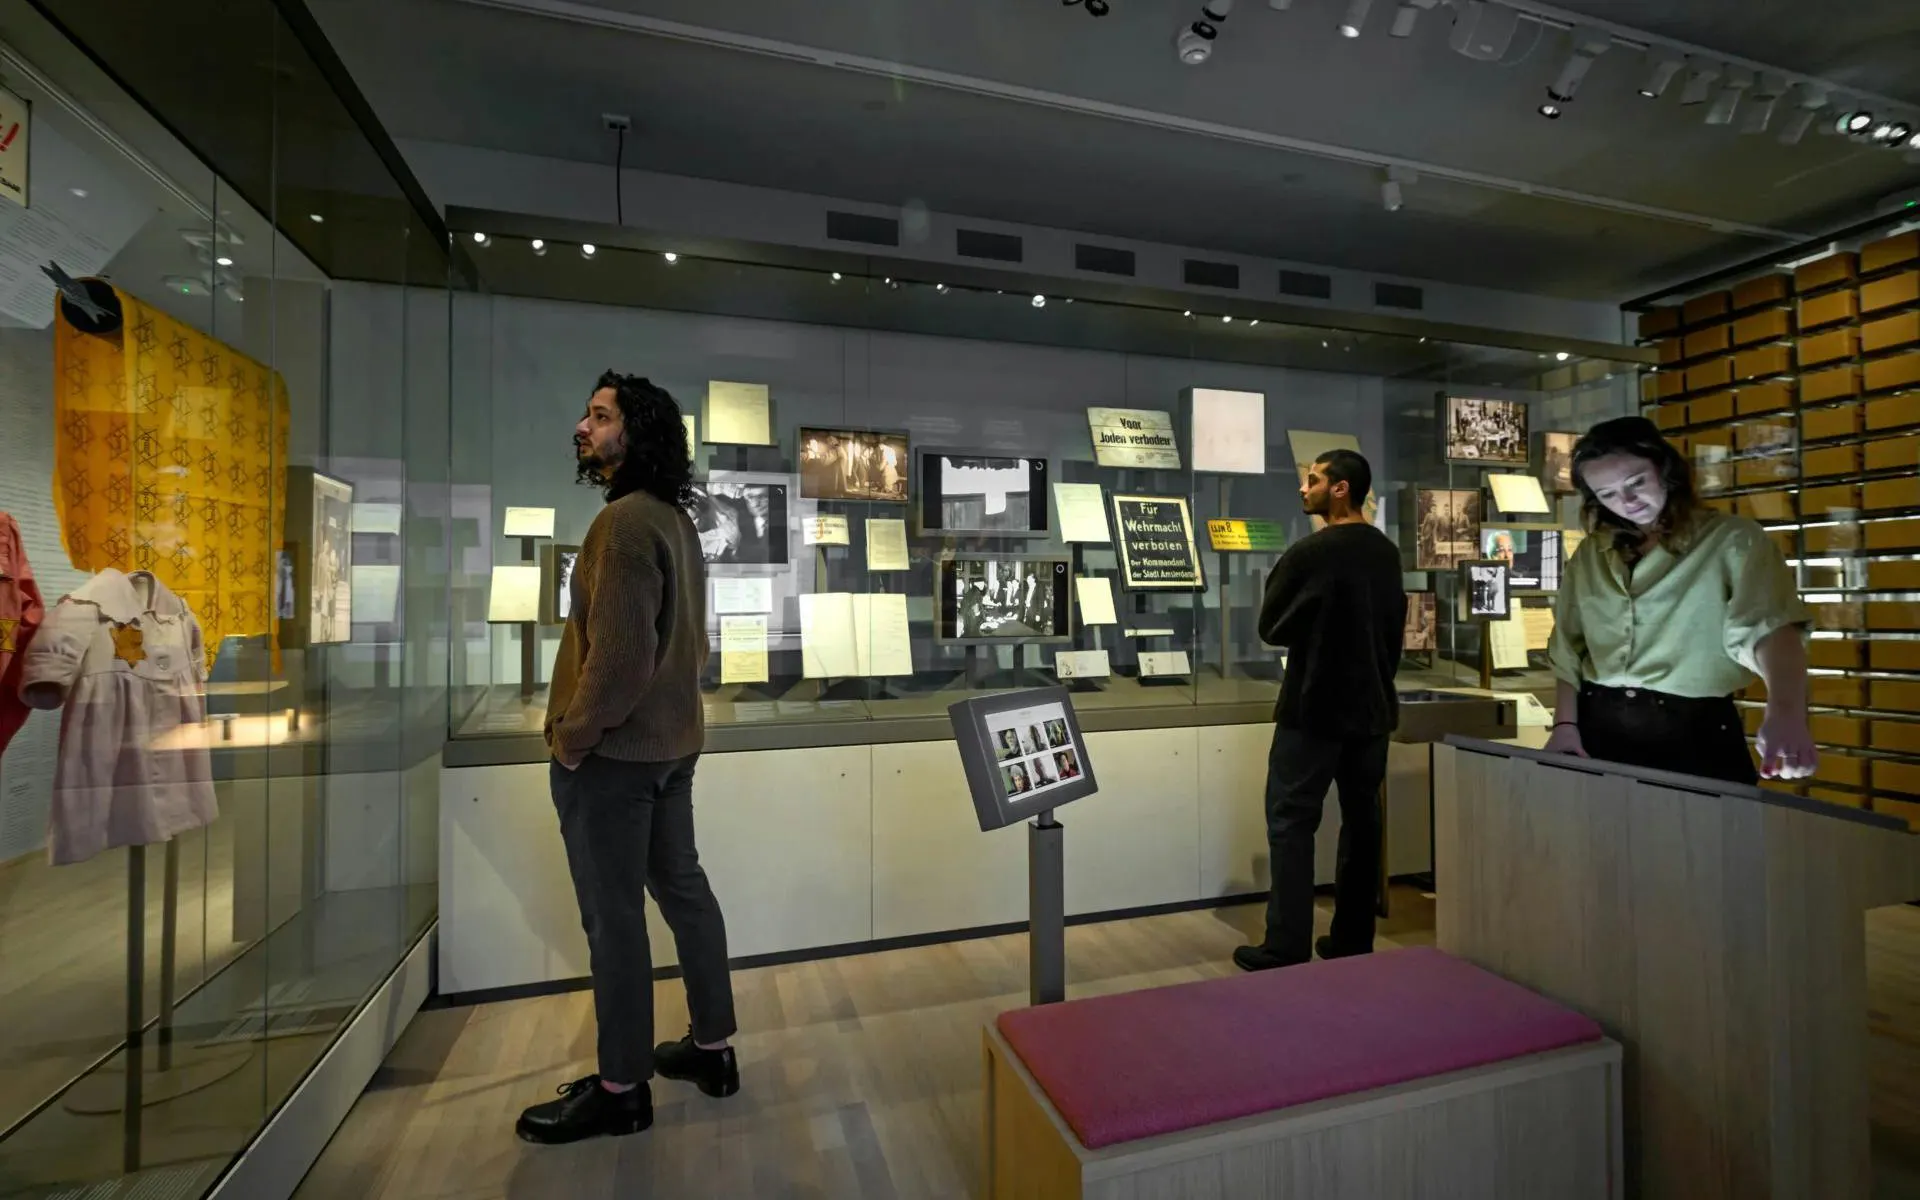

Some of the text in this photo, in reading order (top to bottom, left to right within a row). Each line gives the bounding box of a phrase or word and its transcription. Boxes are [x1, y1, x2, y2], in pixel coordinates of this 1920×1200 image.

[1120, 417, 1141, 430] Voor
[1100, 431, 1171, 446] Joden verboden
[1140, 502, 1158, 515] Für
[1125, 520, 1182, 532] Wehrmacht
[1131, 538, 1182, 551] verboten
